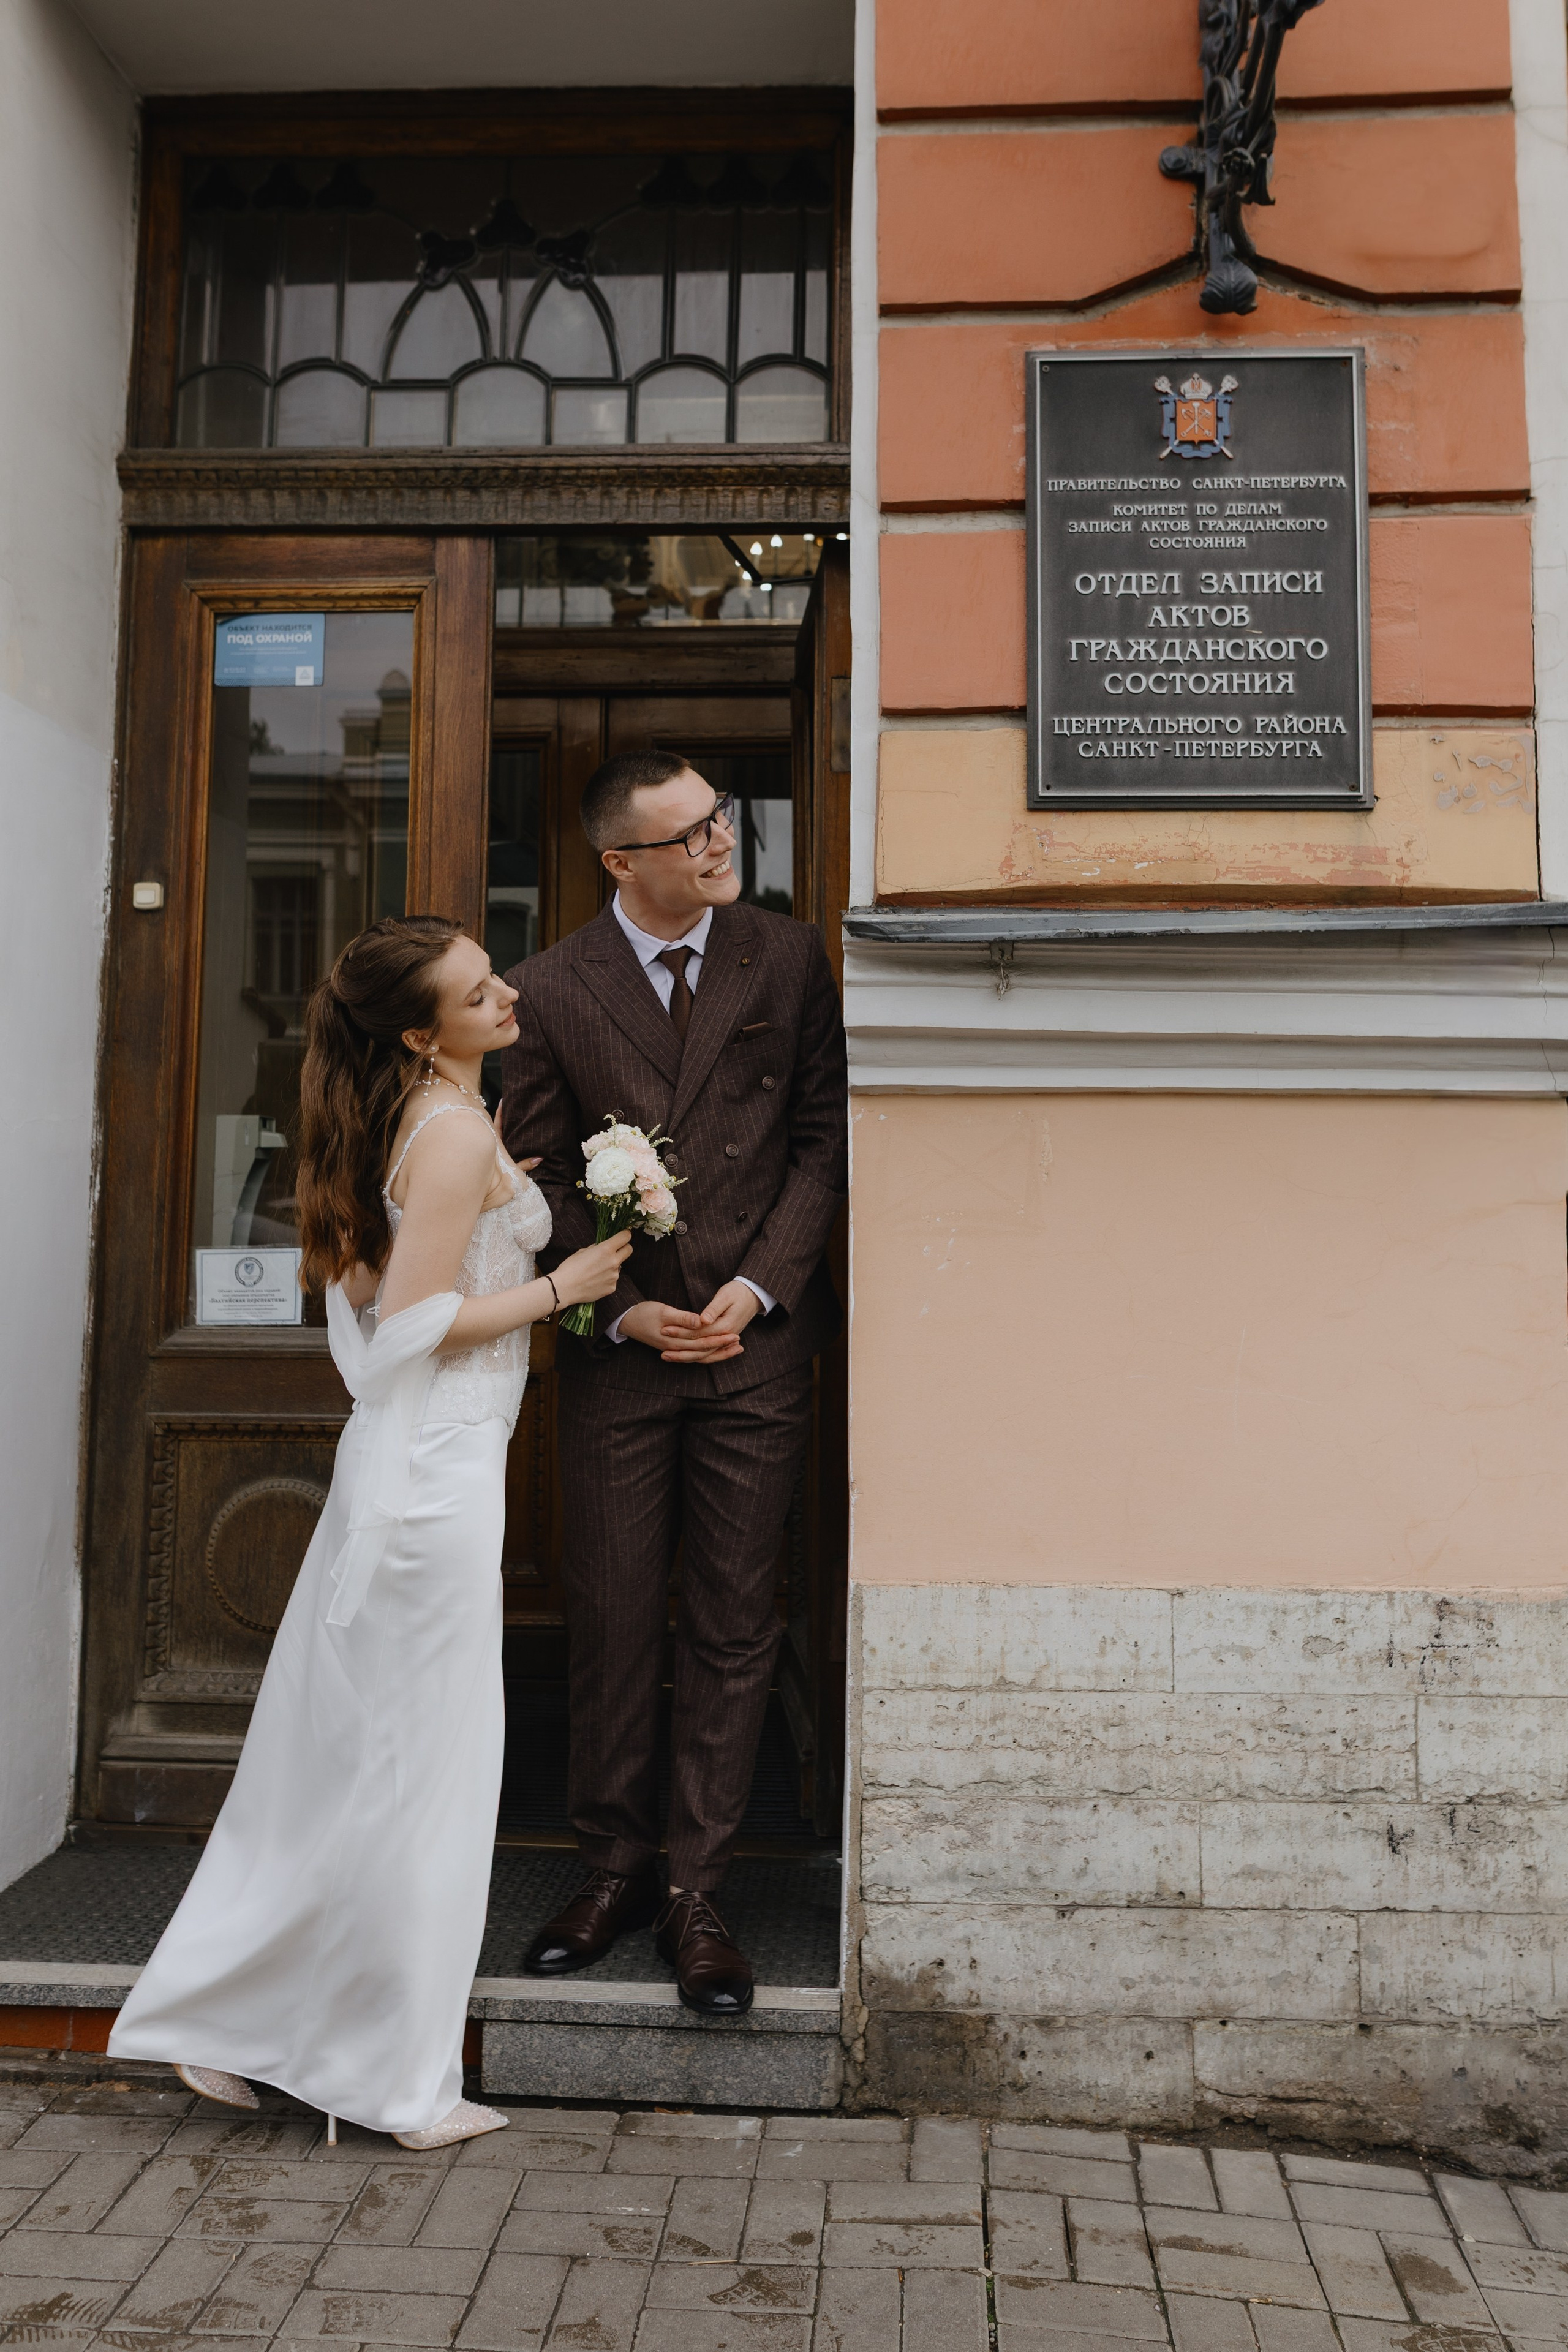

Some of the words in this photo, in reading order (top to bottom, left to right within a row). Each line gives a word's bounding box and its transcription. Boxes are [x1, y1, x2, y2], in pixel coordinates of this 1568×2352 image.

[1046, 478, 1182, 491] ПРАВИТЕЛЬСТВО
[1191, 475, 1348, 489] САНКТ-ПЕТЕРБУРГА
[1113, 503, 1188, 516] КОМИТЕТ
[1196, 503, 1218, 515] ПО
[1224, 502, 1283, 516] ДЕЛАМ
[1068, 520, 1132, 533] ЗАПИСИ
[1140, 519, 1191, 532] АКТОВ
[1198, 518, 1329, 533] ГРАЖДАНСКОГО
[1149, 535, 1247, 549] СОСТОЯНИЯ
[1074, 571, 1182, 598] ОТДЕЛ
[1200, 570, 1324, 594] ЗАПИСИ
[1147, 605, 1251, 628] АКТОВ
[227, 634, 254, 645] ПОД
[255, 631, 312, 643] ОХРАНОЙ
[1068, 637, 1329, 665] ГРАЖДАНСКОГО
[1104, 671, 1296, 694] СОСТОЯНИЯ
[1052, 715, 1243, 737] ЦЕНТРАЛЬНОГО
[1253, 713, 1348, 734] РАЙОНА
[1078, 739, 1324, 758] САНКТ-ПЕТЕРБУРГА
